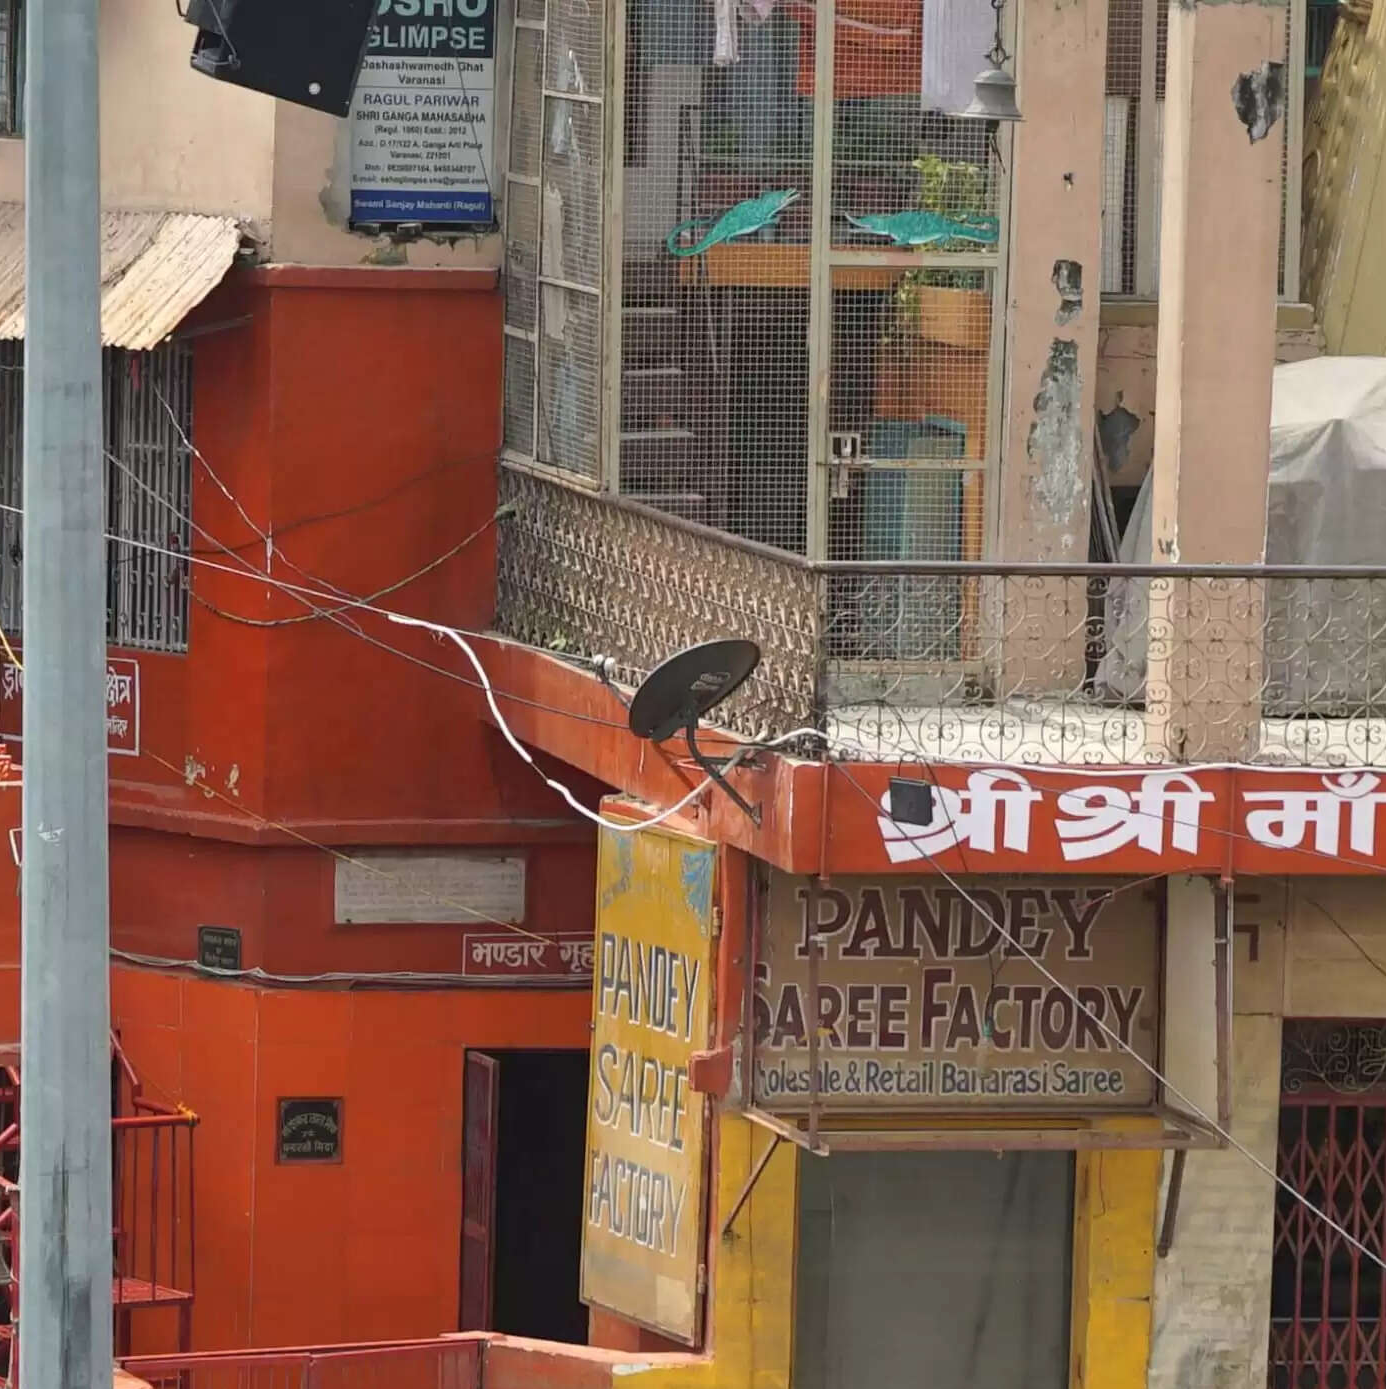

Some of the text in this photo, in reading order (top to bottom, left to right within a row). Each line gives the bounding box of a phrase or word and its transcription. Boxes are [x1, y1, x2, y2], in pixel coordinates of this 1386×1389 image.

[367, 22, 486, 50] GLIMPSE
[361, 59, 484, 73] Dashashwamedh Ghat
[398, 74, 445, 85] Varanasi
[356, 110, 486, 123] SHRI GANGA MAHASABHA
[363, 93, 479, 108] RAGUL PARIWAR
[878, 769, 1044, 863] श्री
[1054, 771, 1216, 862] श्री
[796, 887, 1113, 961] PANDEY
[471, 941, 547, 968] भण्डार
[598, 931, 701, 1043] PANDEY
[920, 966, 1144, 1054] FACTORY
[845, 1060, 862, 1094] &
[865, 1060, 935, 1095] Retail
[1051, 1061, 1126, 1096] Saree
[595, 1042, 692, 1153] SAREE
[588, 1148, 686, 1260] FACTORY
